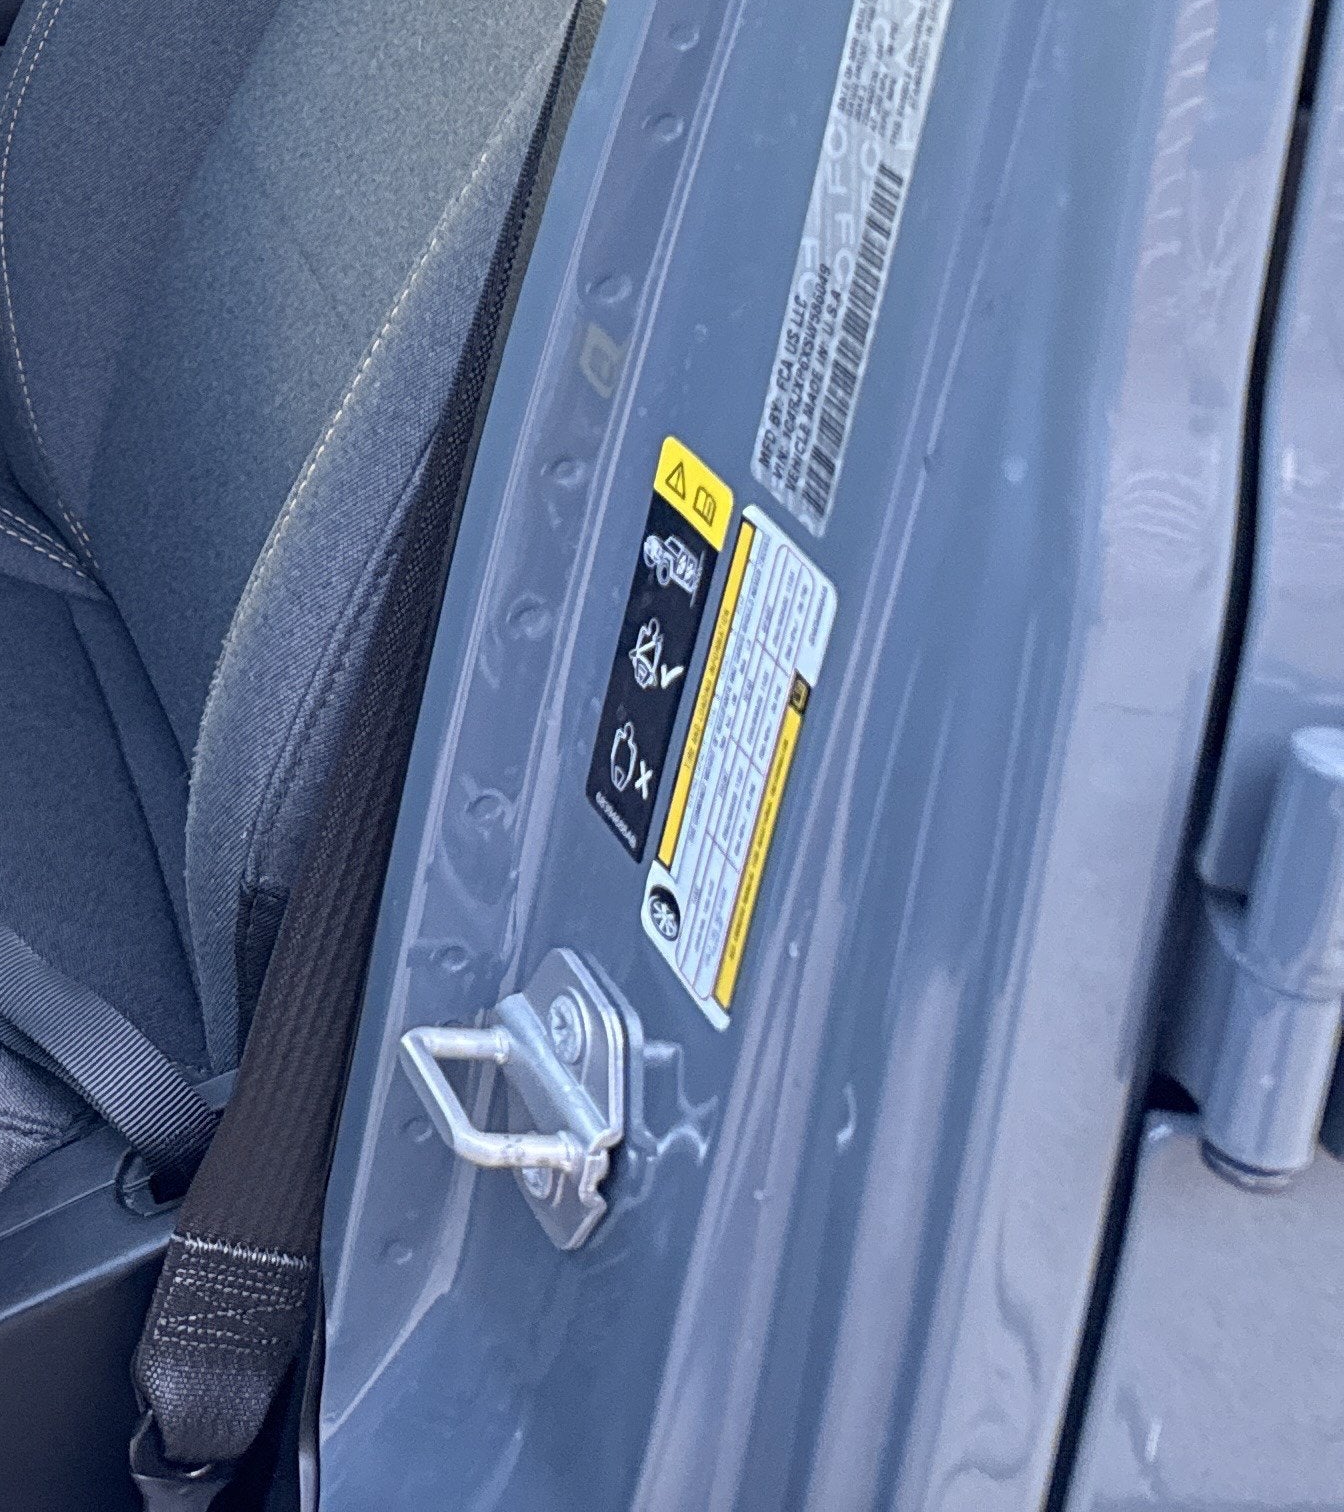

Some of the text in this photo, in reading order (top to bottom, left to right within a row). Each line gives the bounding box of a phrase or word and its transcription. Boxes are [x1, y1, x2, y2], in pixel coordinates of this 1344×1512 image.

[789, 292, 807, 328] LLC
[783, 326, 800, 357] US
[775, 355, 793, 394] FCA
[758, 426, 776, 470] MFD
[784, 420, 810, 495] VEHICLE
[801, 366, 823, 421] MADE
